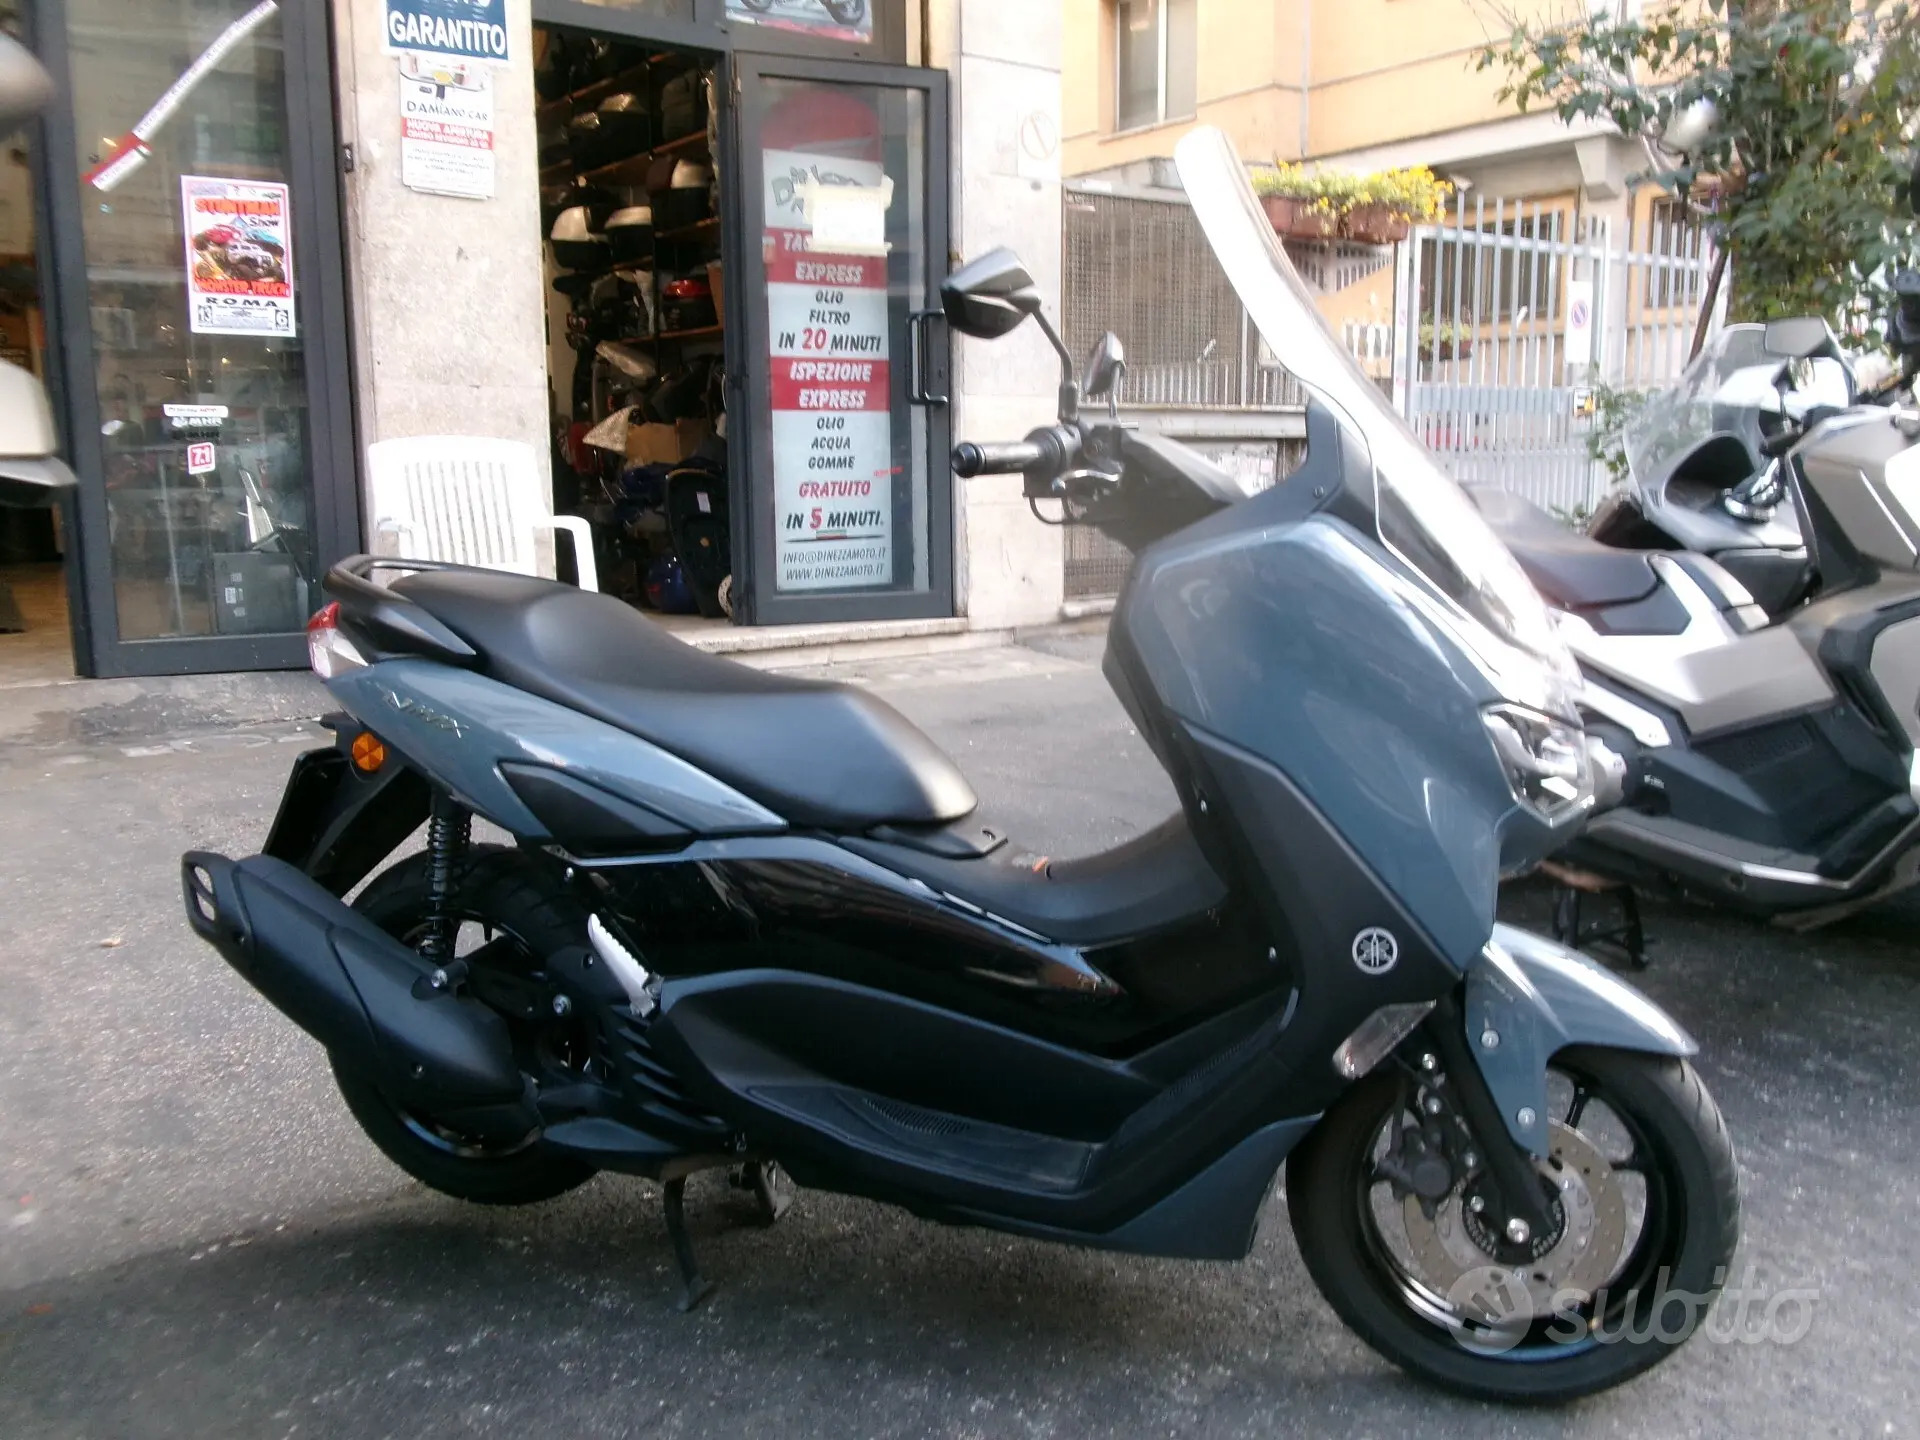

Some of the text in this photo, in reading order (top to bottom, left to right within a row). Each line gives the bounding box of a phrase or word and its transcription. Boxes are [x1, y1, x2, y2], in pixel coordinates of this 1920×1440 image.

[389, 10, 506, 55] GARANTITO
[407, 100, 488, 121] DAMIANO CAR
[795, 260, 864, 284] EXPRESS
[205, 297, 278, 308] ROMA
[815, 289, 844, 304] OLIO
[809, 308, 850, 326] FILTRO
[778, 327, 882, 352] IN 20 MINUTI
[789, 360, 873, 383] ISPEZIONE
[798, 388, 867, 410] EXPRESS
[816, 416, 845, 430] OLIO
[811, 436, 851, 450] ACQUA
[808, 456, 855, 470] GOMME
[799, 480, 871, 498] GRATUITO
[786, 506, 881, 530] IN 5 MINUTI
[783, 546, 887, 564] INFO@DINEZZAMOTO.IT
[786, 563, 885, 580] WWW.DINEZZAMOTO.IT
